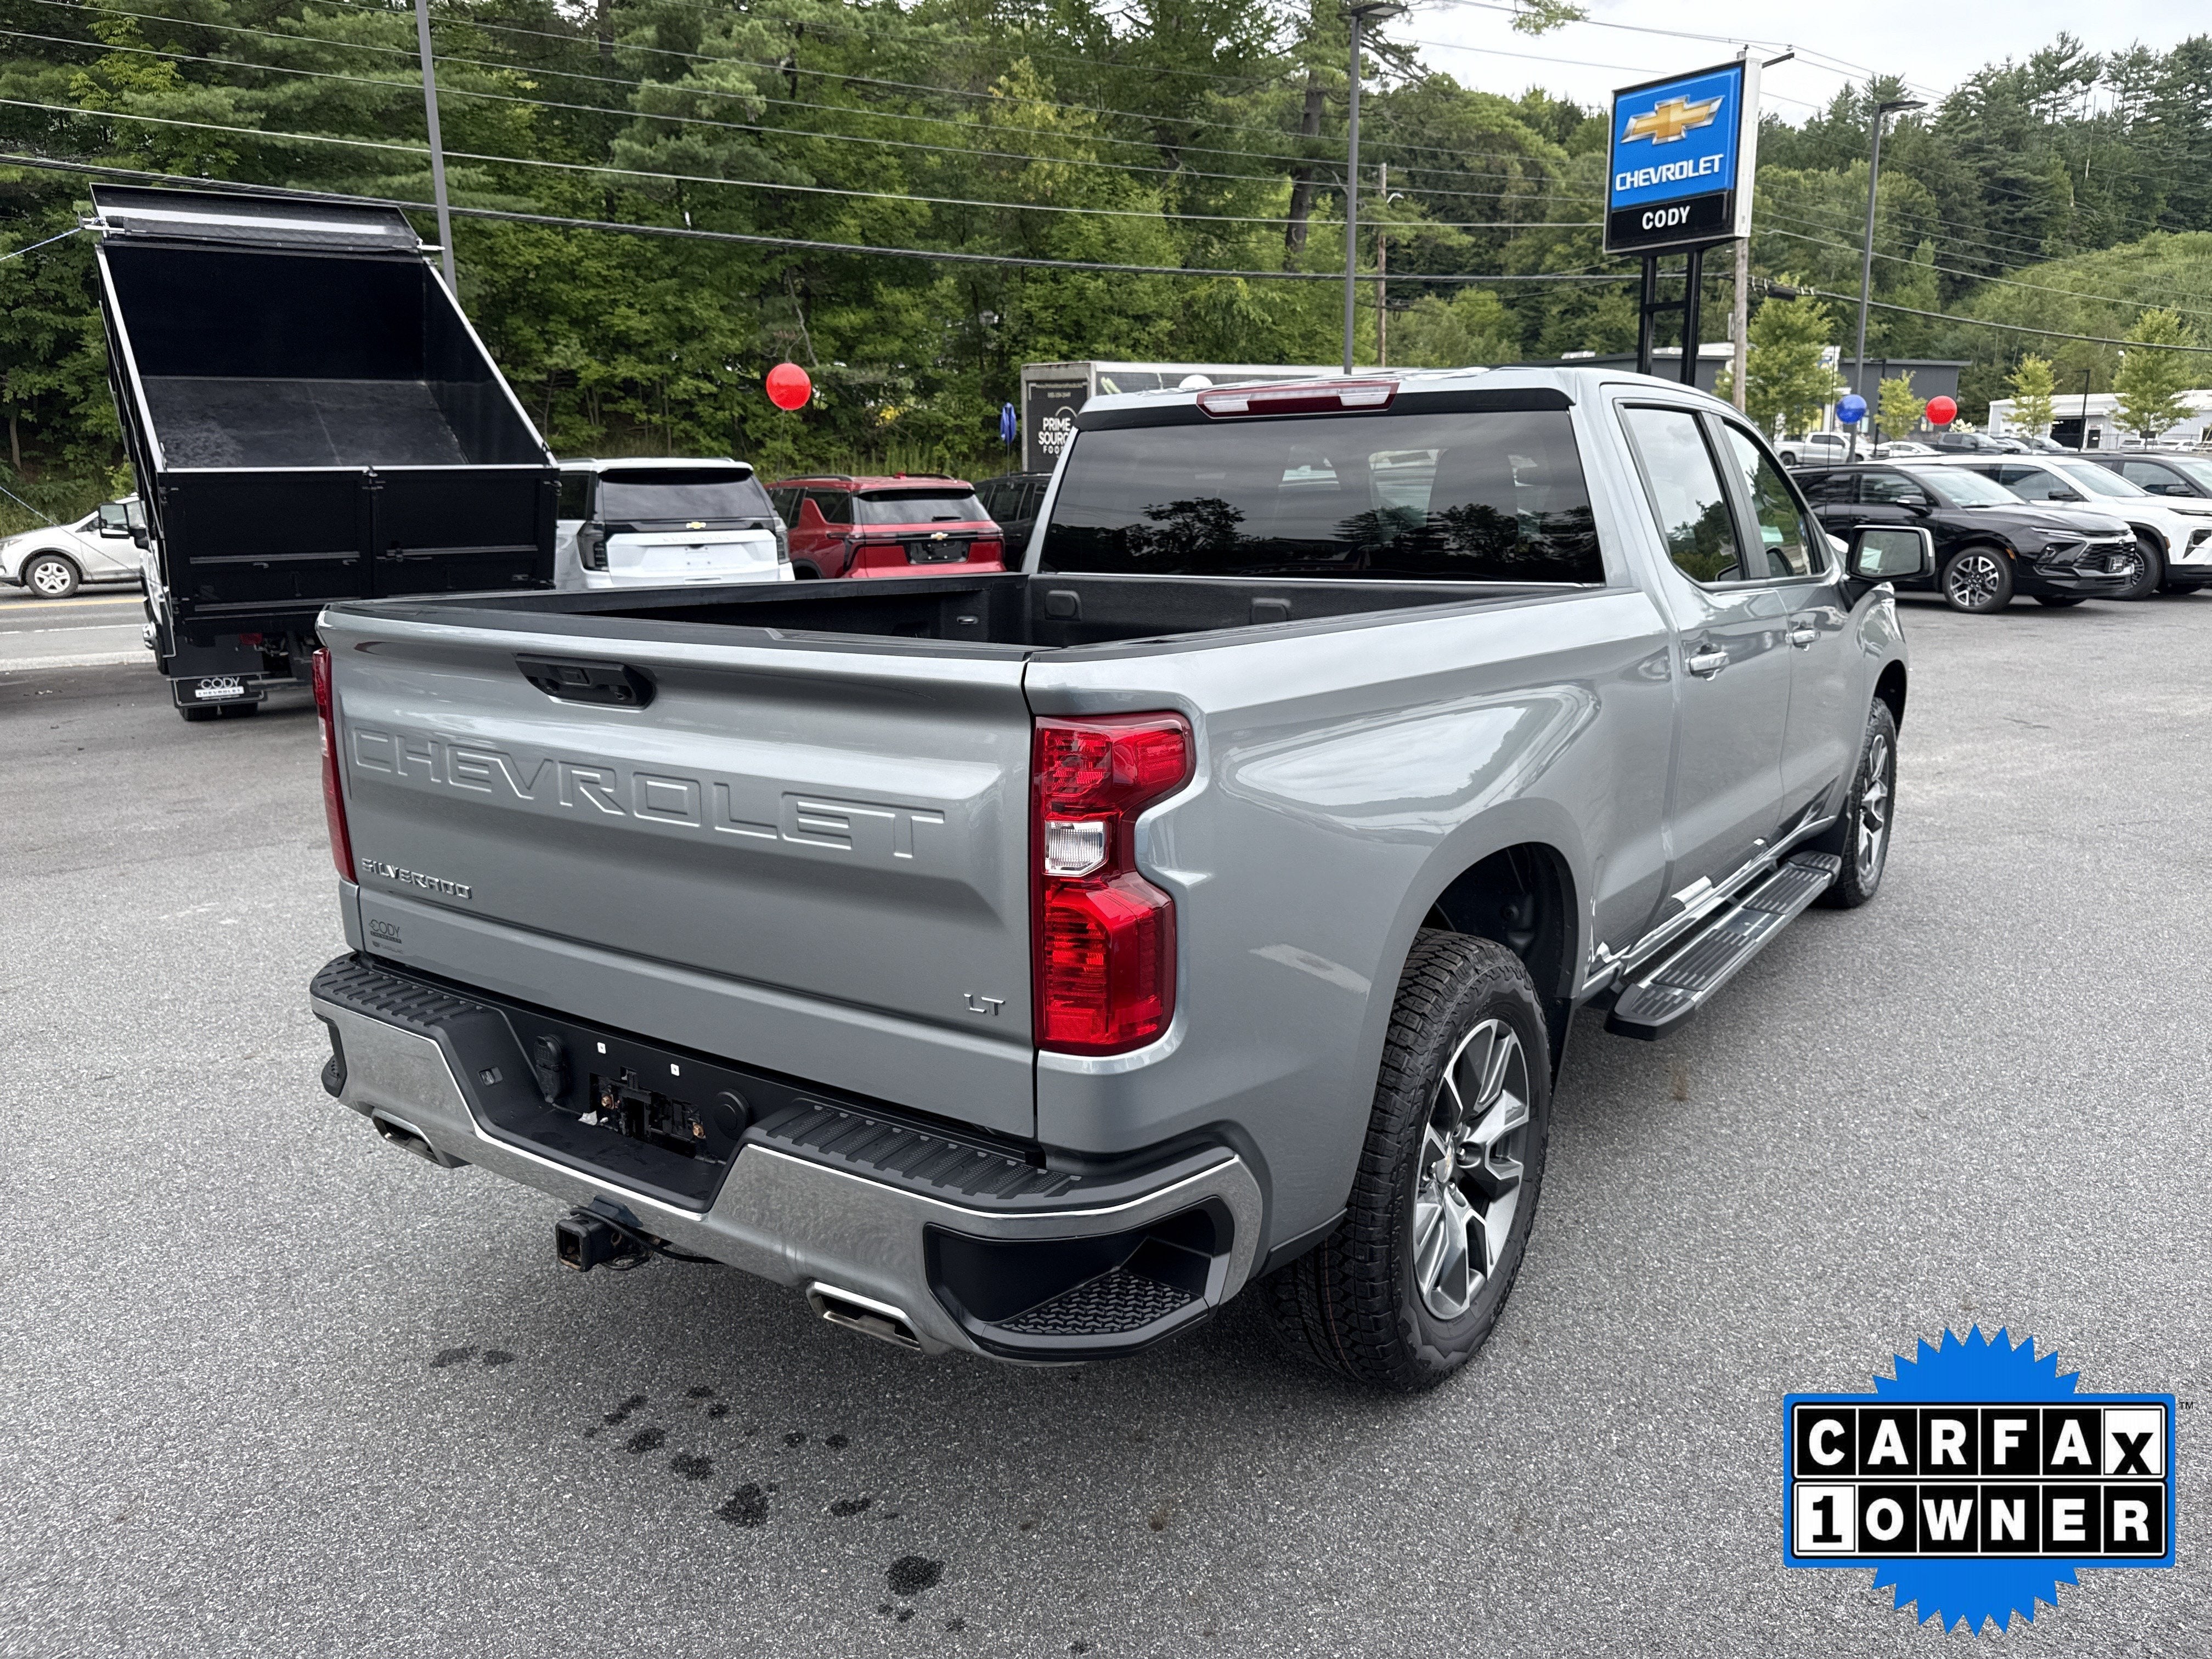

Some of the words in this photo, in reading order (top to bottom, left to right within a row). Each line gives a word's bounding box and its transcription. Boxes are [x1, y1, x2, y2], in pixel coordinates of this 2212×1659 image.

[1615, 153, 1725, 191] CHEVROLET
[1641, 205, 1691, 230] CODY
[1042, 417, 1071, 431] PRIME
[200, 676, 240, 690] CODY
[351, 727, 945, 859] CHEVROLET
[362, 857, 472, 899] SILVERADO
[370, 919, 400, 937] CODY
[963, 993, 1005, 1015] LT
